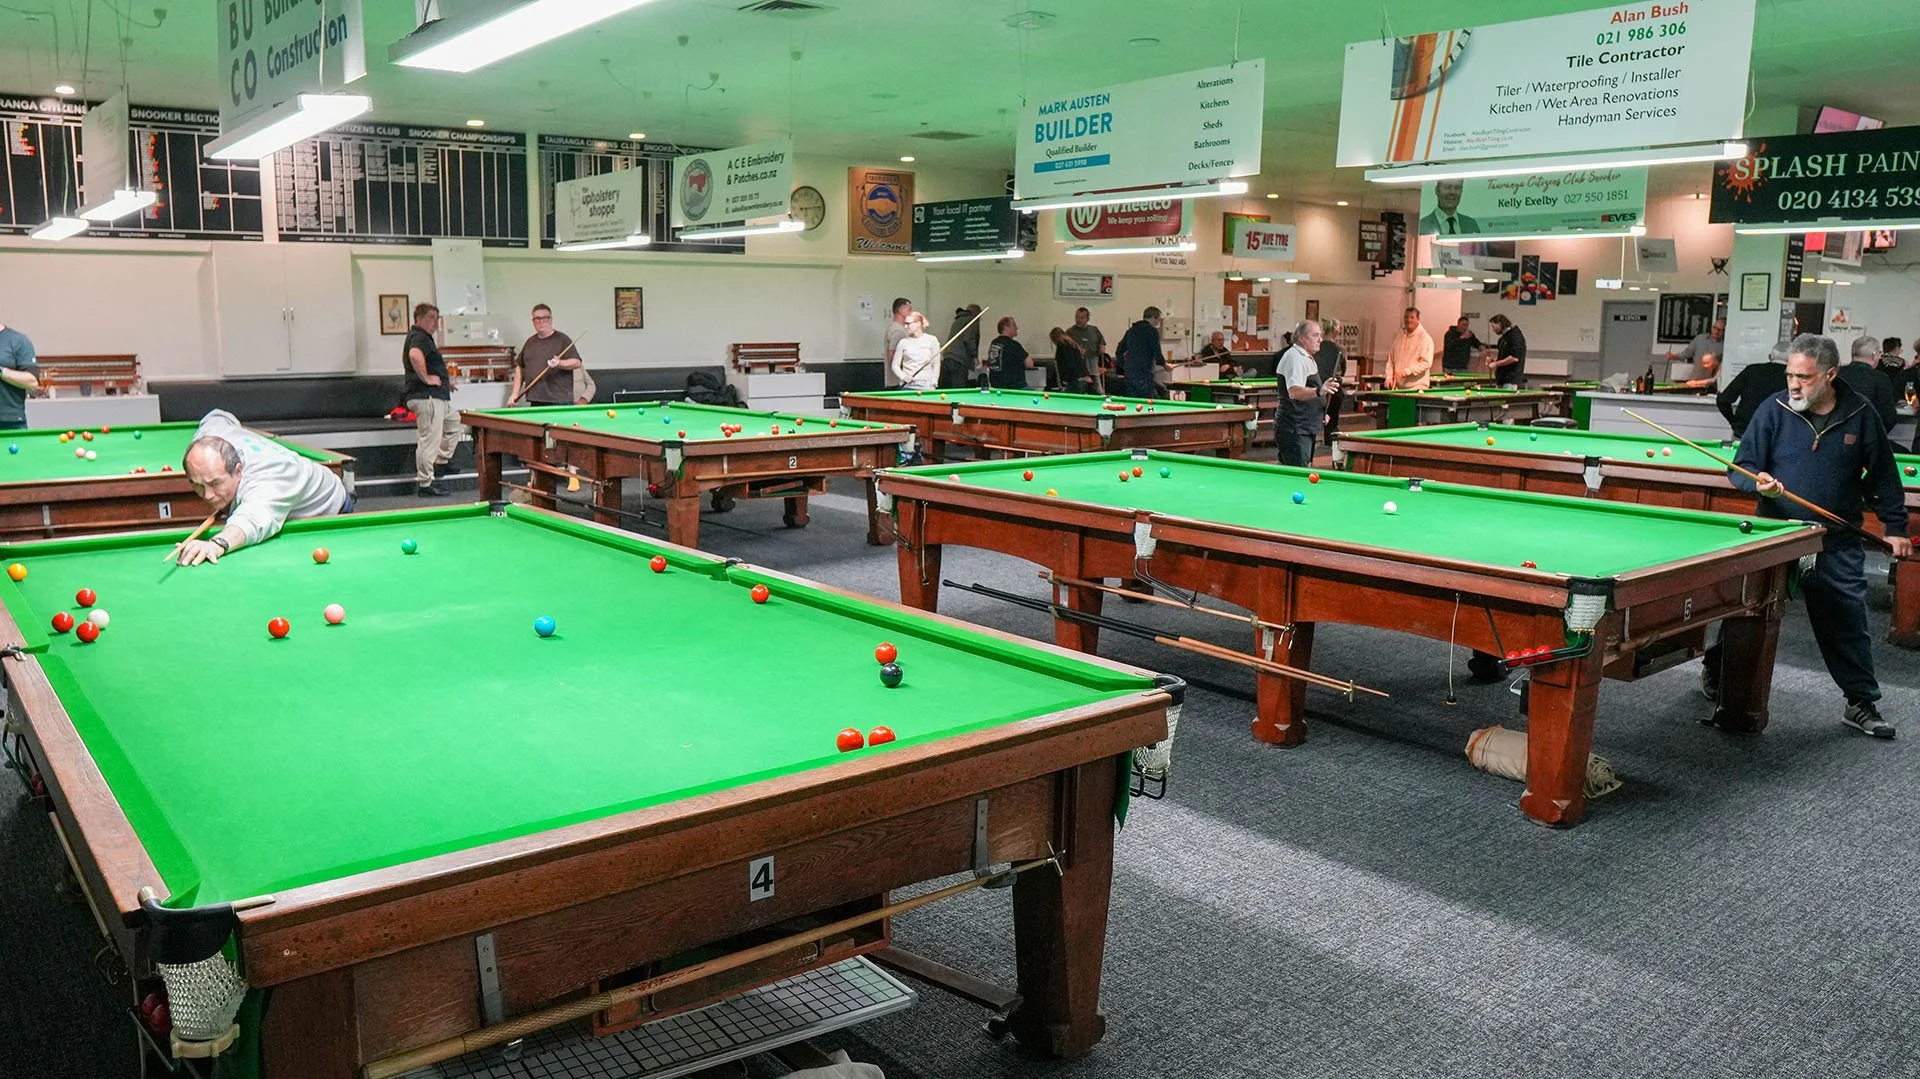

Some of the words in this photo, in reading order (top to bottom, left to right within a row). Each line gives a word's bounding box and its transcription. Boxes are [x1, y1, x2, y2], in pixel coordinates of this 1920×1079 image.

[1610, 10, 1646, 25] Alan
[1650, 2, 1690, 19] Bush
[1596, 31, 1621, 46] 021
[1627, 27, 1654, 43] 986
[1659, 21, 1687, 38] 306
[267, 14, 348, 79] Construction
[1566, 54, 1594, 69] Tile
[1598, 43, 1686, 65] Contractor
[231, 49, 257, 107] CO
[1196, 76, 1234, 90] Alterations
[1496, 84, 1522, 98] Tiler
[1631, 68, 1682, 84] Installer
[1038, 99, 1067, 116] MARK
[1069, 93, 1111, 111] AUSTEN
[1199, 98, 1230, 110] Kitchens
[1489, 101, 1533, 116] Kitchen
[1569, 94, 1598, 108] Area
[1602, 86, 1679, 105] Renovations
[131, 109, 181, 122] SNOOKER
[1557, 106, 1621, 128] Handyman
[1625, 105, 1677, 121] Services
[1034, 111, 1113, 144] BUILDER
[1202, 120, 1223, 131] Sheds
[376, 127, 400, 137] CLUB
[408, 129, 450, 140] SNOOKER
[450, 131, 516, 144] CHAMPIONSHIPS
[544, 136, 586, 146] TAURANGA
[1193, 137, 1231, 150] Bathrooms
[1046, 144, 1074, 158] Qualified
[1074, 142, 1098, 154] Builder
[747, 151, 786, 167] Embroidery
[1188, 158, 1235, 171] Decks/Fences
[1734, 153, 1848, 181] SPLASH
[726, 175, 732, 186] &
[733, 169, 778, 184] Patches.co.nz
[1487, 177, 1525, 195] Tauranga
[1526, 175, 1560, 193] Citizens
[1563, 171, 1585, 186] Club
[1587, 169, 1621, 183] Snooker
[581, 188, 621, 207] upholstery
[1107, 198, 1171, 214] Wheelco
[1498, 197, 1521, 210] Kelly
[1525, 195, 1558, 208] Exelby
[1564, 192, 1582, 204] 027
[1584, 191, 1603, 203] 550
[1606, 189, 1629, 201] 1851
[1777, 190, 1822, 211] 020
[1827, 188, 1878, 209] 4134
[589, 203, 616, 218] shoppe
[932, 206, 945, 216] Your
[946, 204, 961, 215] local
[962, 203, 968, 213] IT
[968, 204, 992, 215] partner
[1607, 212, 1637, 222] EVES
[1107, 216, 1117, 224] We
[1118, 215, 1133, 226] keep
[1134, 216, 1146, 225] you
[1146, 213, 1168, 224] rolling
[1262, 233, 1274, 246] AVE
[1275, 233, 1289, 247] TYRE
[790, 457, 796, 467] 2
[162, 504, 169, 516] 1
[1685, 601, 1691, 618] 5
[752, 862, 774, 892] 4
